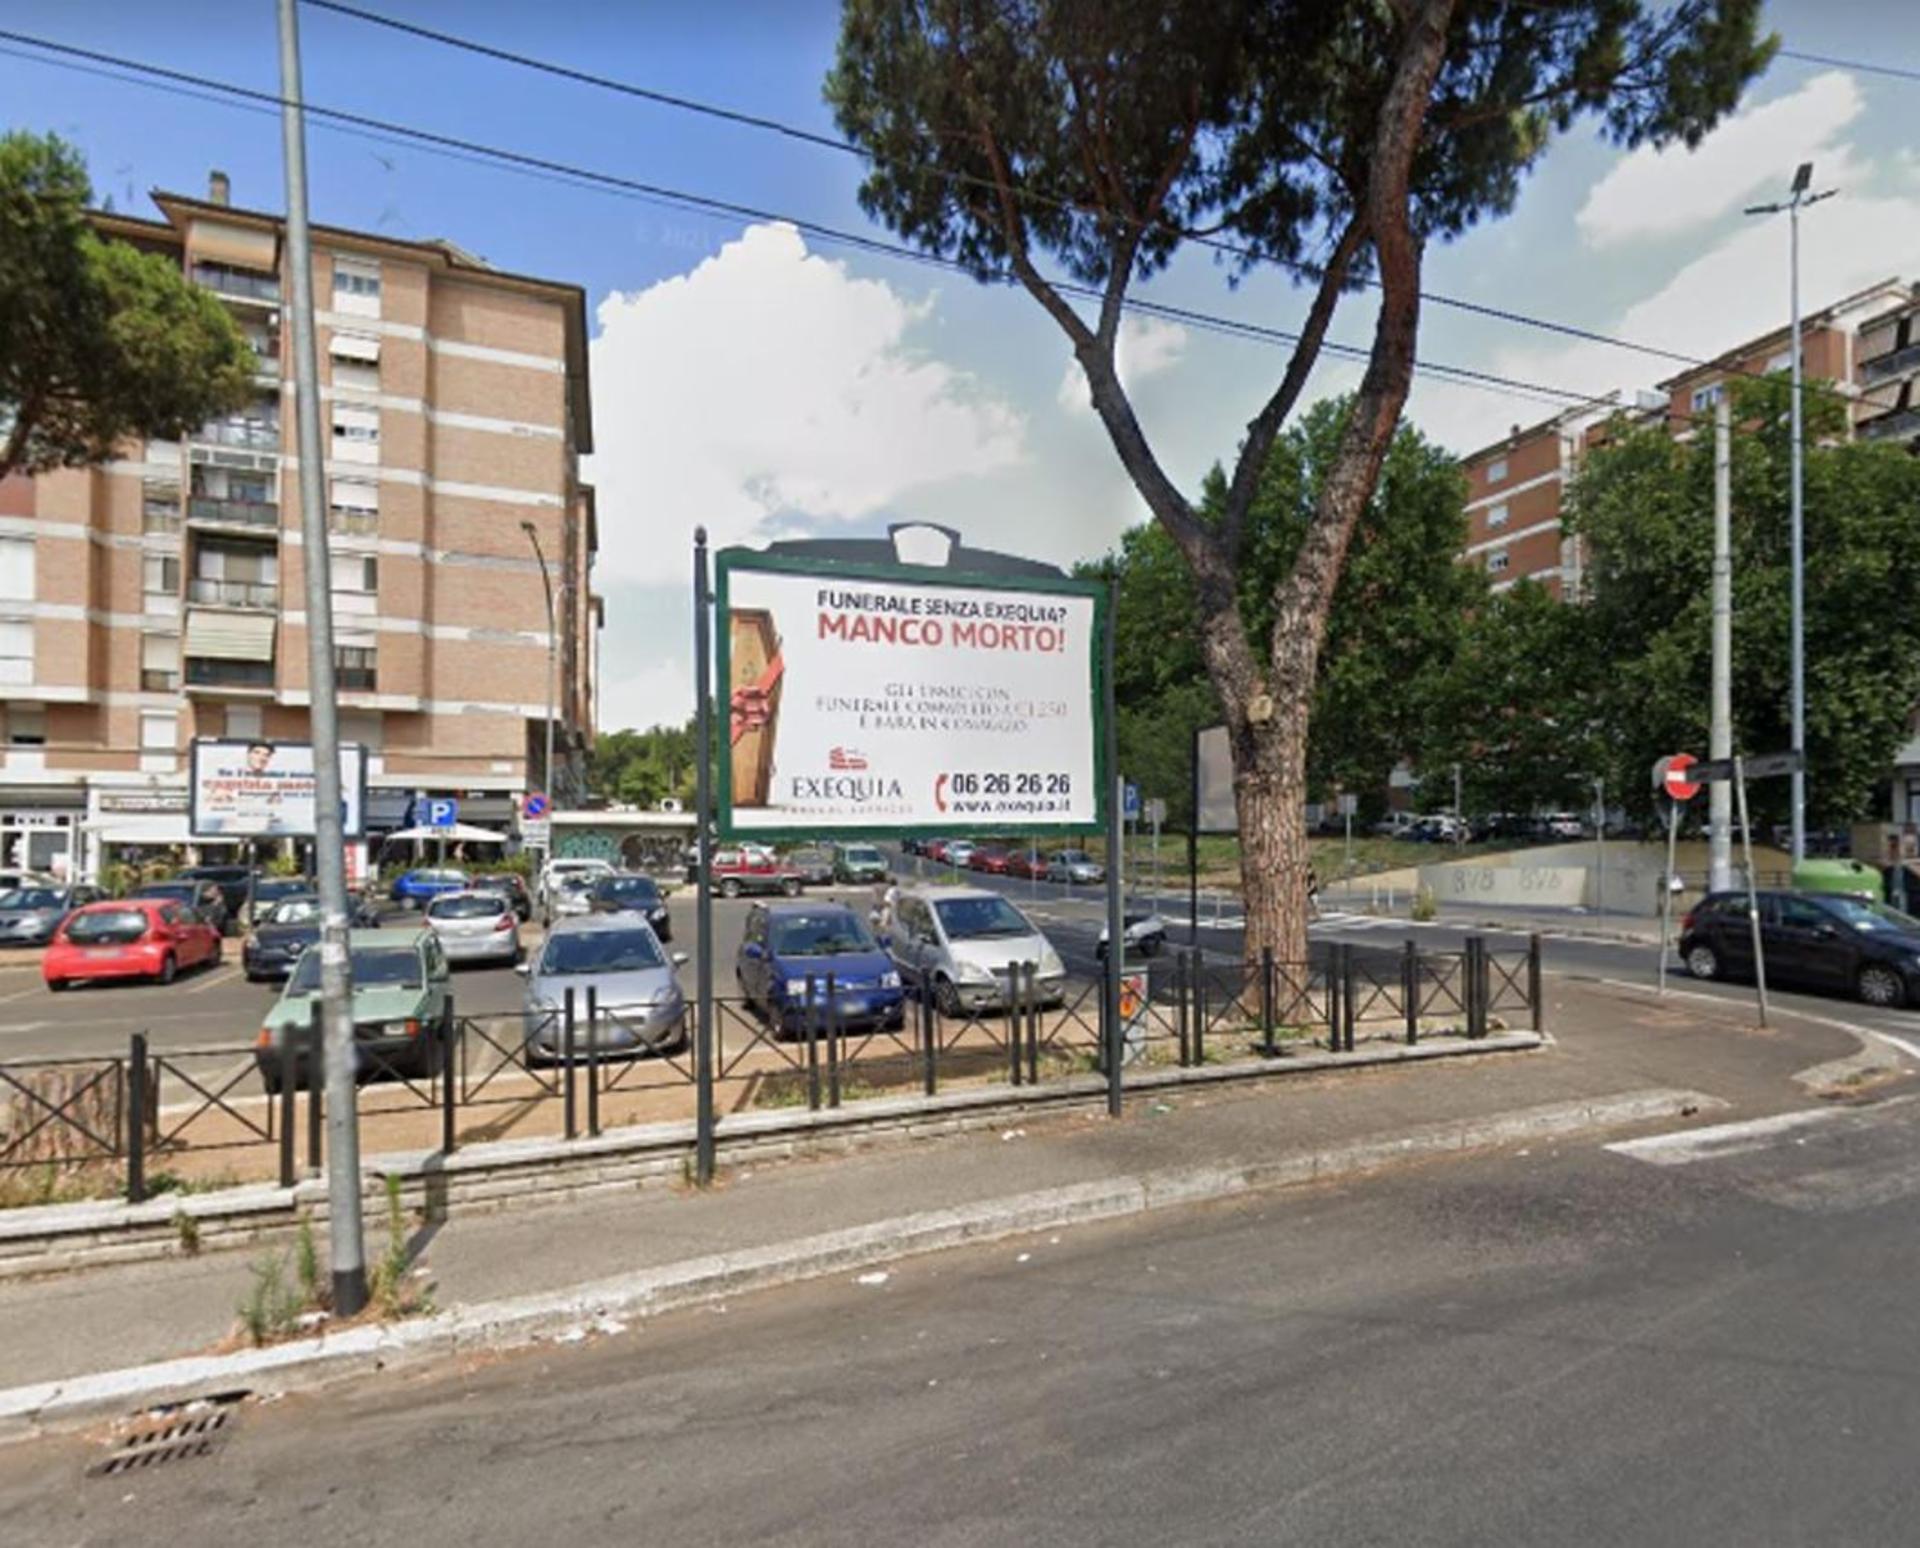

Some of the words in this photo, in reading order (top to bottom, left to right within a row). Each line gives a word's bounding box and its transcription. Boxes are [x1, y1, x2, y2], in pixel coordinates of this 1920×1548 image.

[817, 590, 922, 616] FUNERALE
[924, 597, 982, 619] SENZA
[983, 600, 1067, 623] EXEQUIA?
[817, 613, 944, 647] MANCO
[952, 620, 1065, 653] MORTO!
[792, 776, 903, 802] EXEQUIA
[952, 773, 979, 795] 06
[983, 773, 1010, 795] 26
[1015, 773, 1043, 795] 26
[1046, 773, 1070, 795] 26
[430, 802, 451, 825] P
